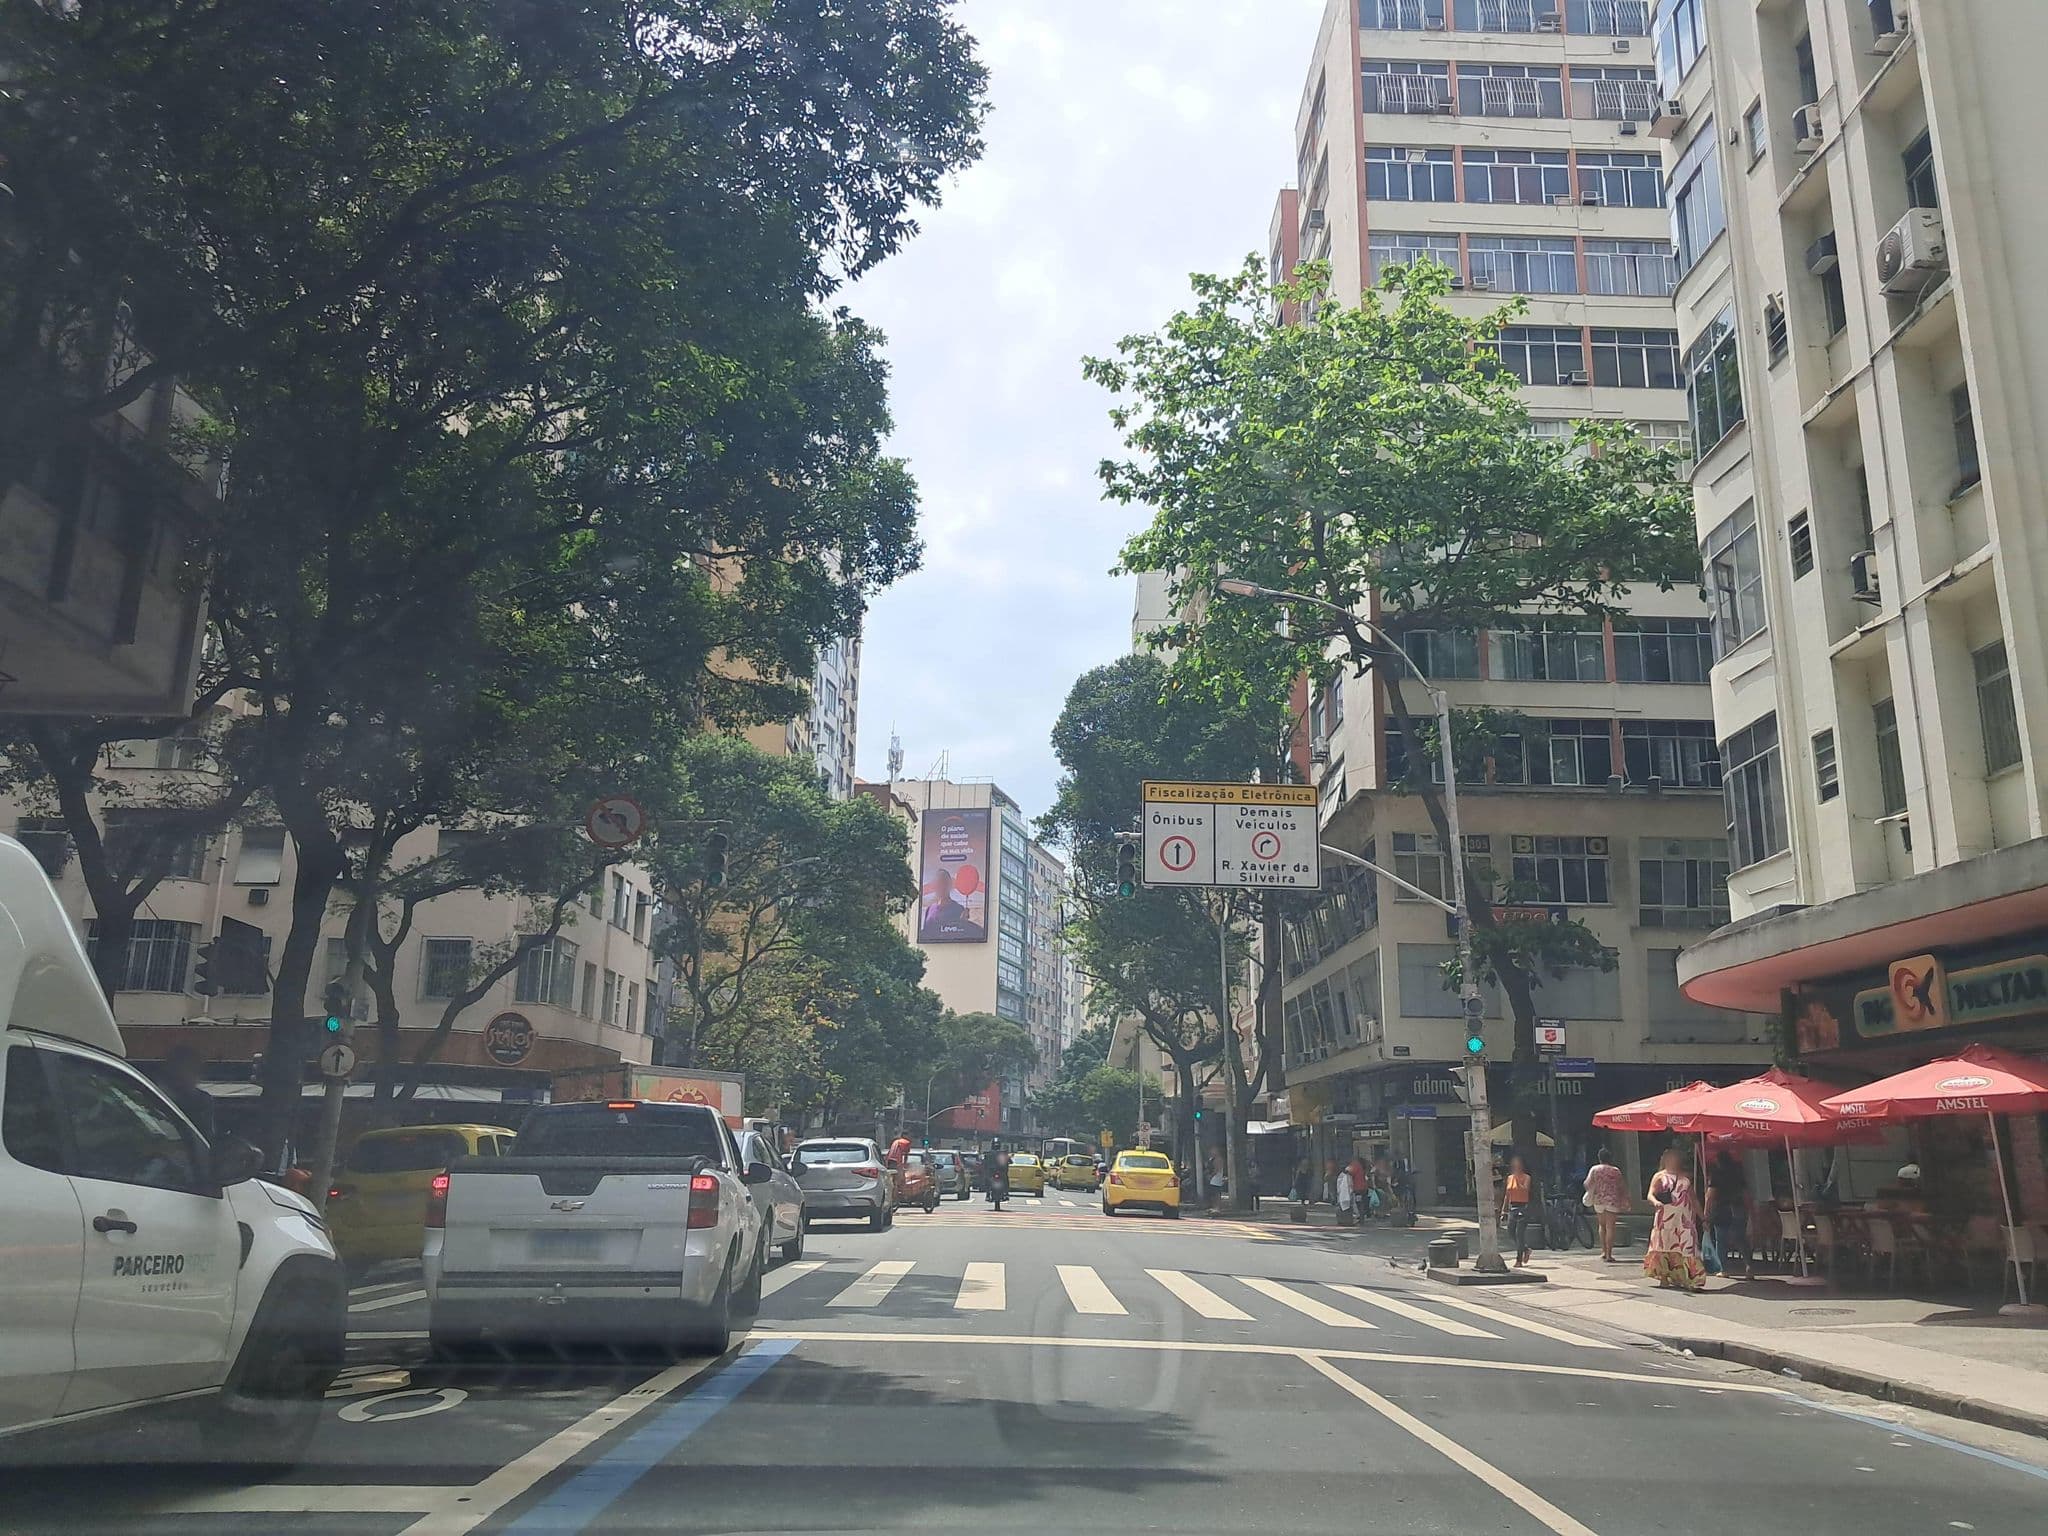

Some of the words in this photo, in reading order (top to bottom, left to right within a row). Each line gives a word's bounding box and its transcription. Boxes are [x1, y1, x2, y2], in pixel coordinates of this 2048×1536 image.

[1150, 788, 1234, 800] Fiscalização
[1242, 789, 1311, 801] Eletrônica
[1152, 811, 1203, 826] Ônibus
[1240, 807, 1292, 818] Demais
[1235, 818, 1296, 831] Veículos
[1222, 861, 1234, 871] R.
[1241, 861, 1287, 872] Xavier
[1293, 862, 1309, 873] da
[1239, 872, 1296, 884] Silveira
[1413, 1073, 1452, 1095] ádom
[1840, 1103, 1868, 1115] AMSTEL
[1936, 1097, 1988, 1111] AMSTEL
[1612, 1114, 1632, 1123] AMSTEL
[1836, 1118, 1871, 1131] AMSTEL
[1732, 1119, 1771, 1131] AMSTEL
